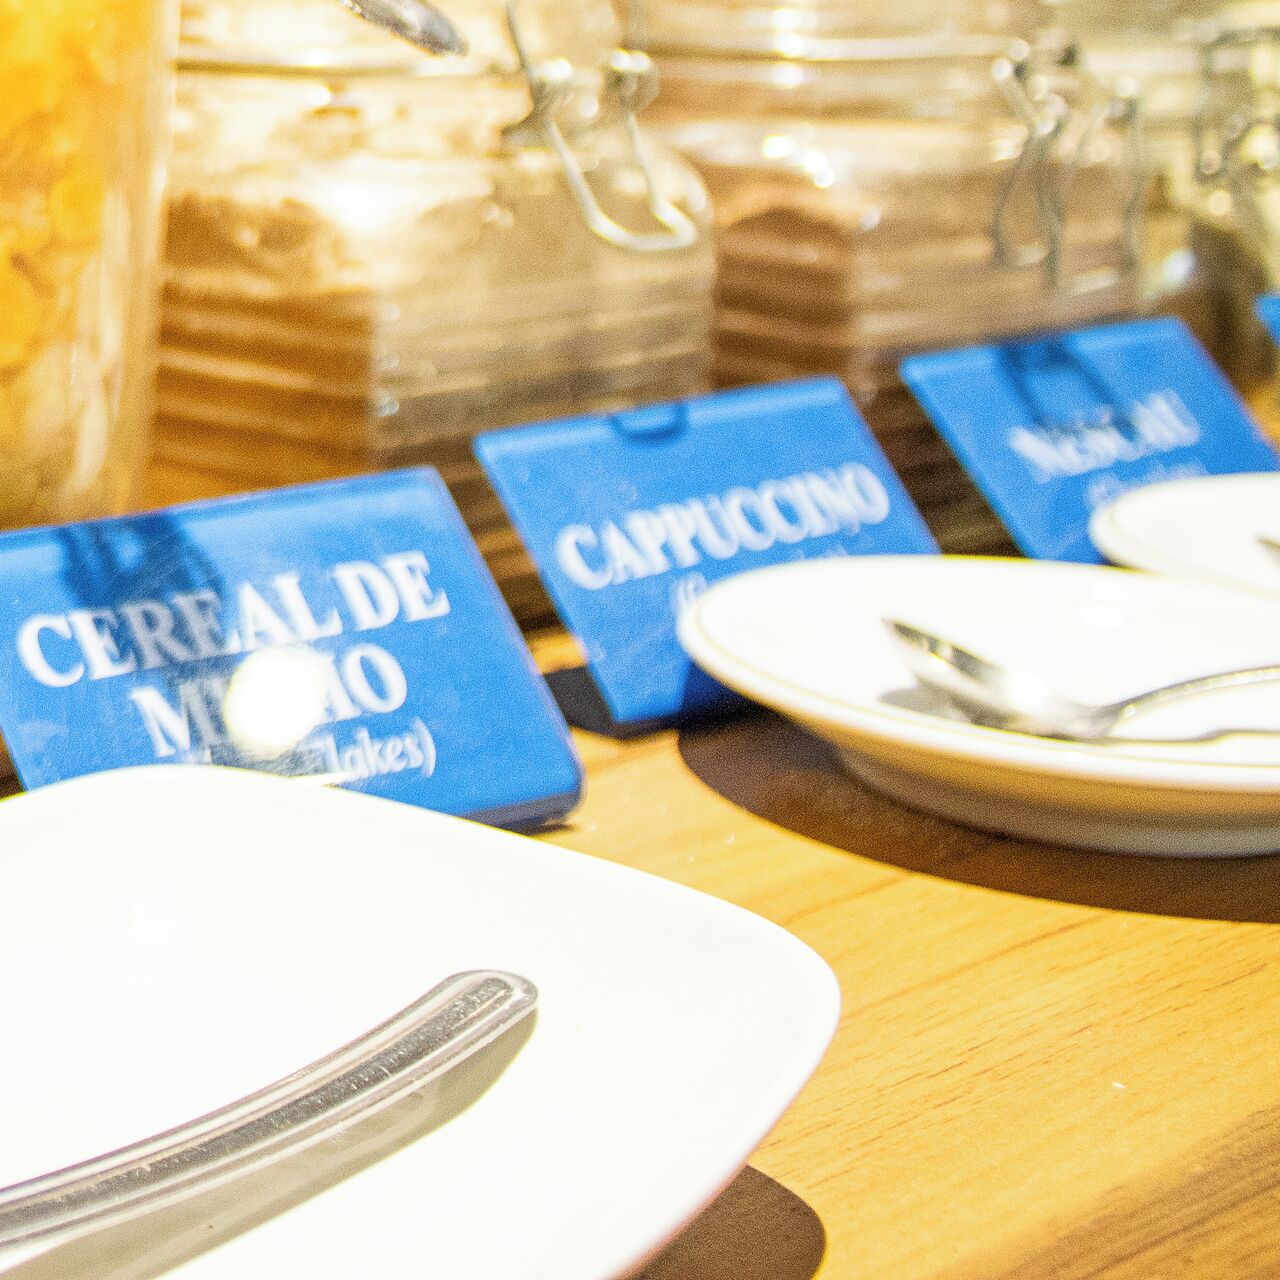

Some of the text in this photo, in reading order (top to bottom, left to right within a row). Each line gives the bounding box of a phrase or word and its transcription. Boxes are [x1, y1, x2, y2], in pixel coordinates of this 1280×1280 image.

[554, 462, 890, 590] CAPPUCCINO
[17, 551, 450, 688] CEREAL DE
